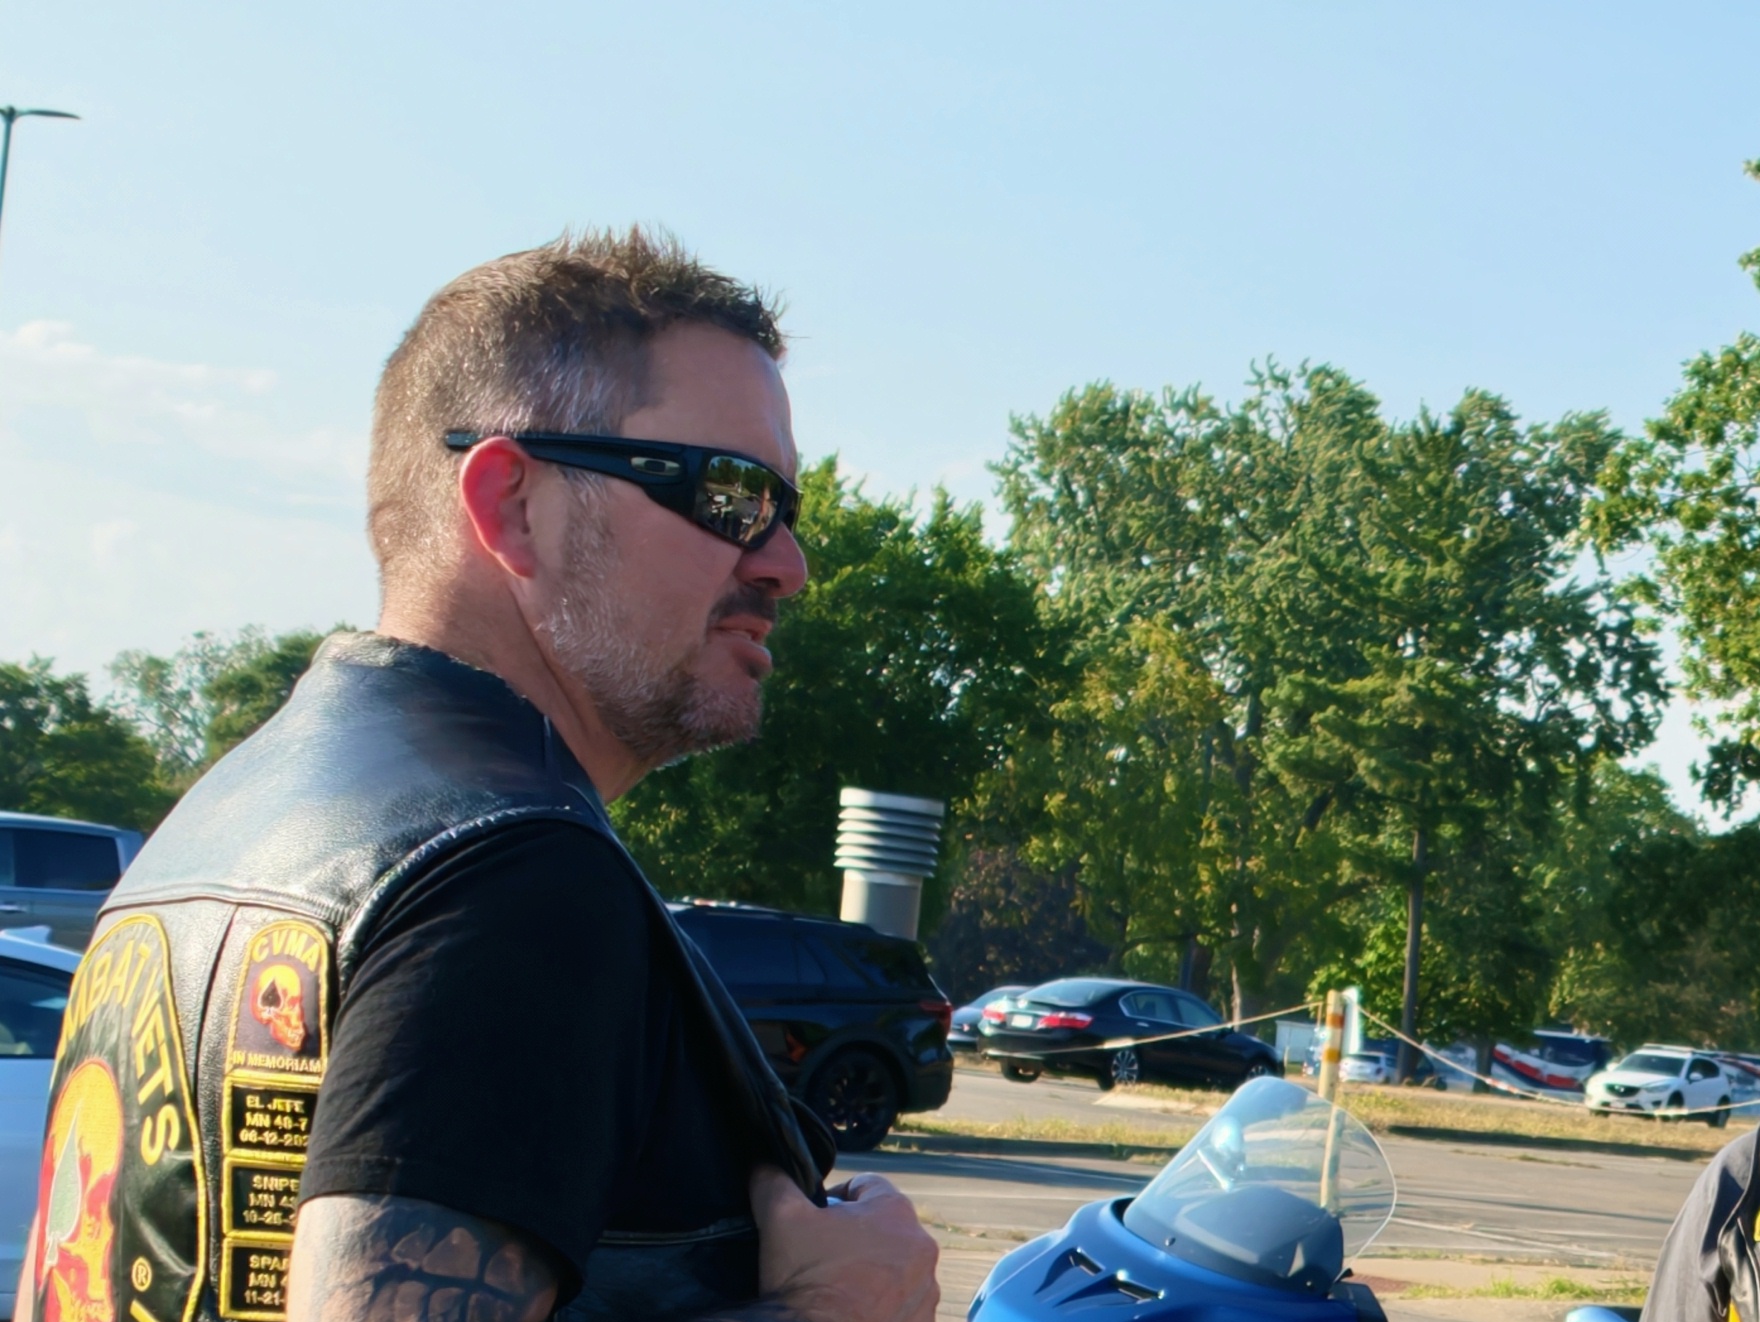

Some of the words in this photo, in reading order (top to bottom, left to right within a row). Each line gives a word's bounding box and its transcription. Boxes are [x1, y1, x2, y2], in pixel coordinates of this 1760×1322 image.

[251, 929, 319, 972] CVMA
[131, 965, 181, 1166] VETS
[233, 1050, 246, 1066] IN
[248, 1053, 322, 1073] MEMORIAM
[246, 1095, 265, 1109] EL
[245, 1112, 271, 1128] MN
[239, 1129, 310, 1147] 06-12-202
[252, 1175, 300, 1192] SNIPE
[249, 1193, 276, 1208] MN
[248, 1272, 276, 1288] MN
